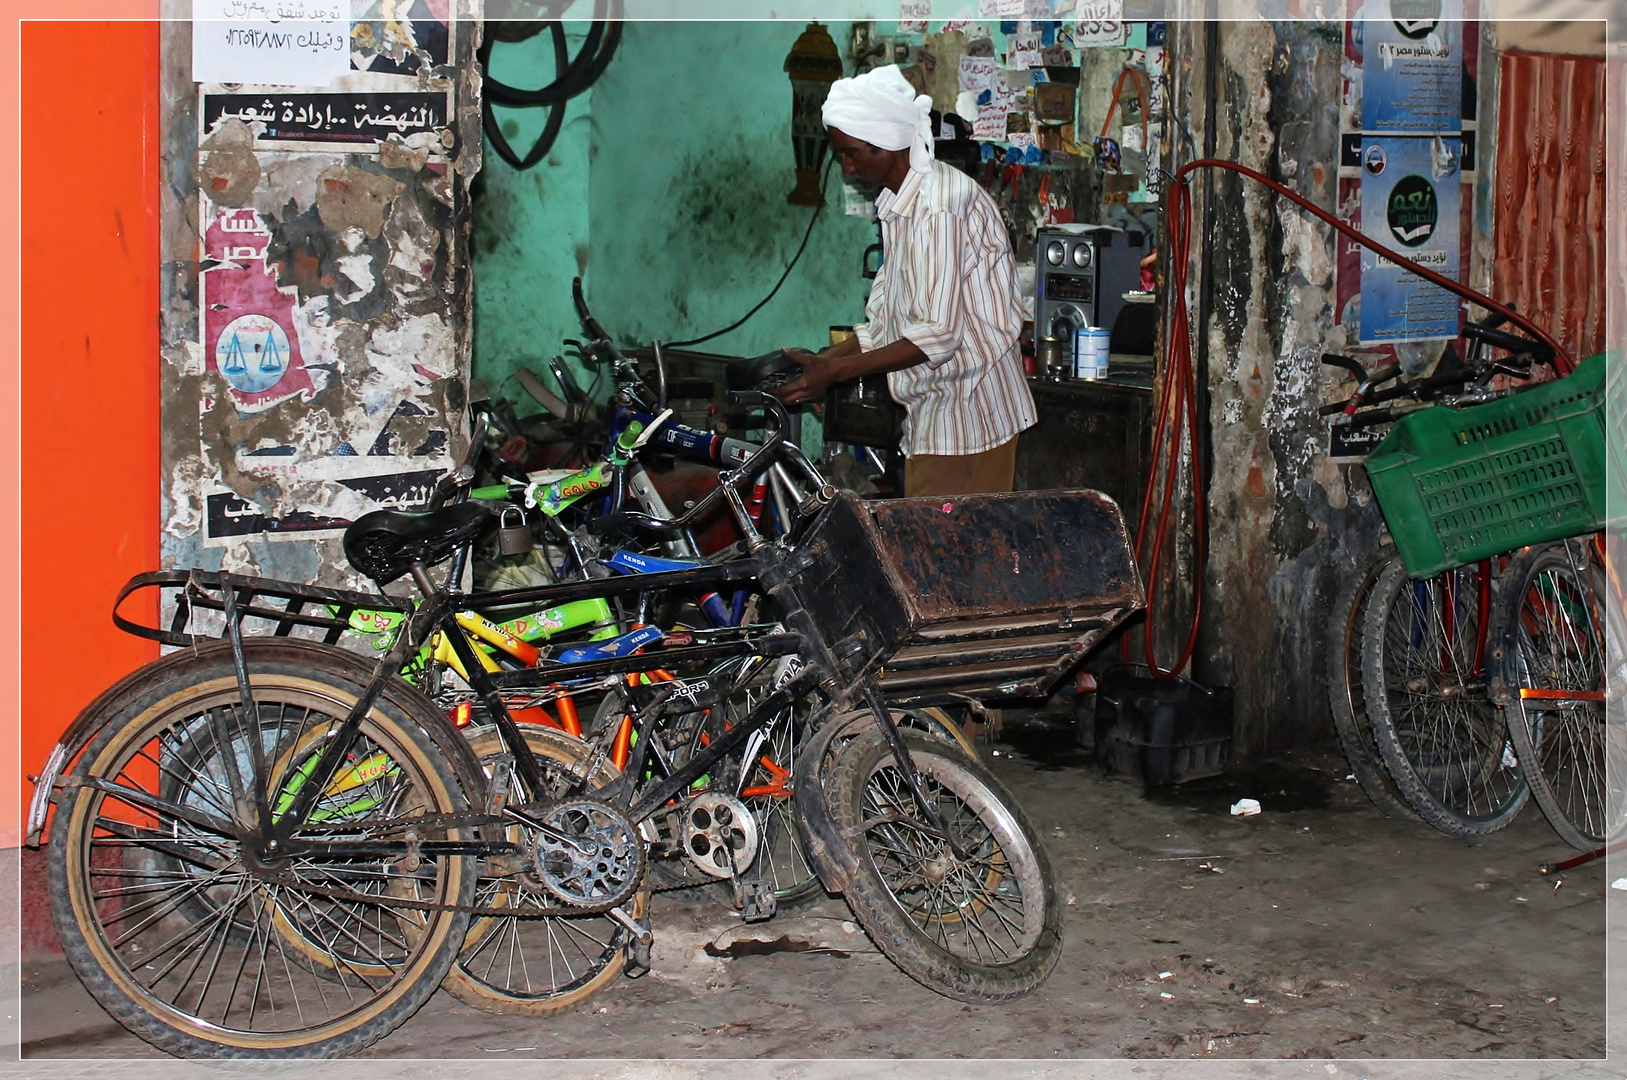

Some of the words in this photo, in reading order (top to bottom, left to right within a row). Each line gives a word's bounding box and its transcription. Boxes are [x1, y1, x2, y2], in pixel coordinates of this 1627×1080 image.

[1396, 47, 1412, 57] مصر
[353, 104, 434, 132] النهضة
[1389, 186, 1431, 213] نعم
[1432, 252, 1446, 264] نؤيد
[562, 479, 600, 498] GOLD
[623, 554, 646, 567] KENDA
[631, 632, 650, 644] KENDA
